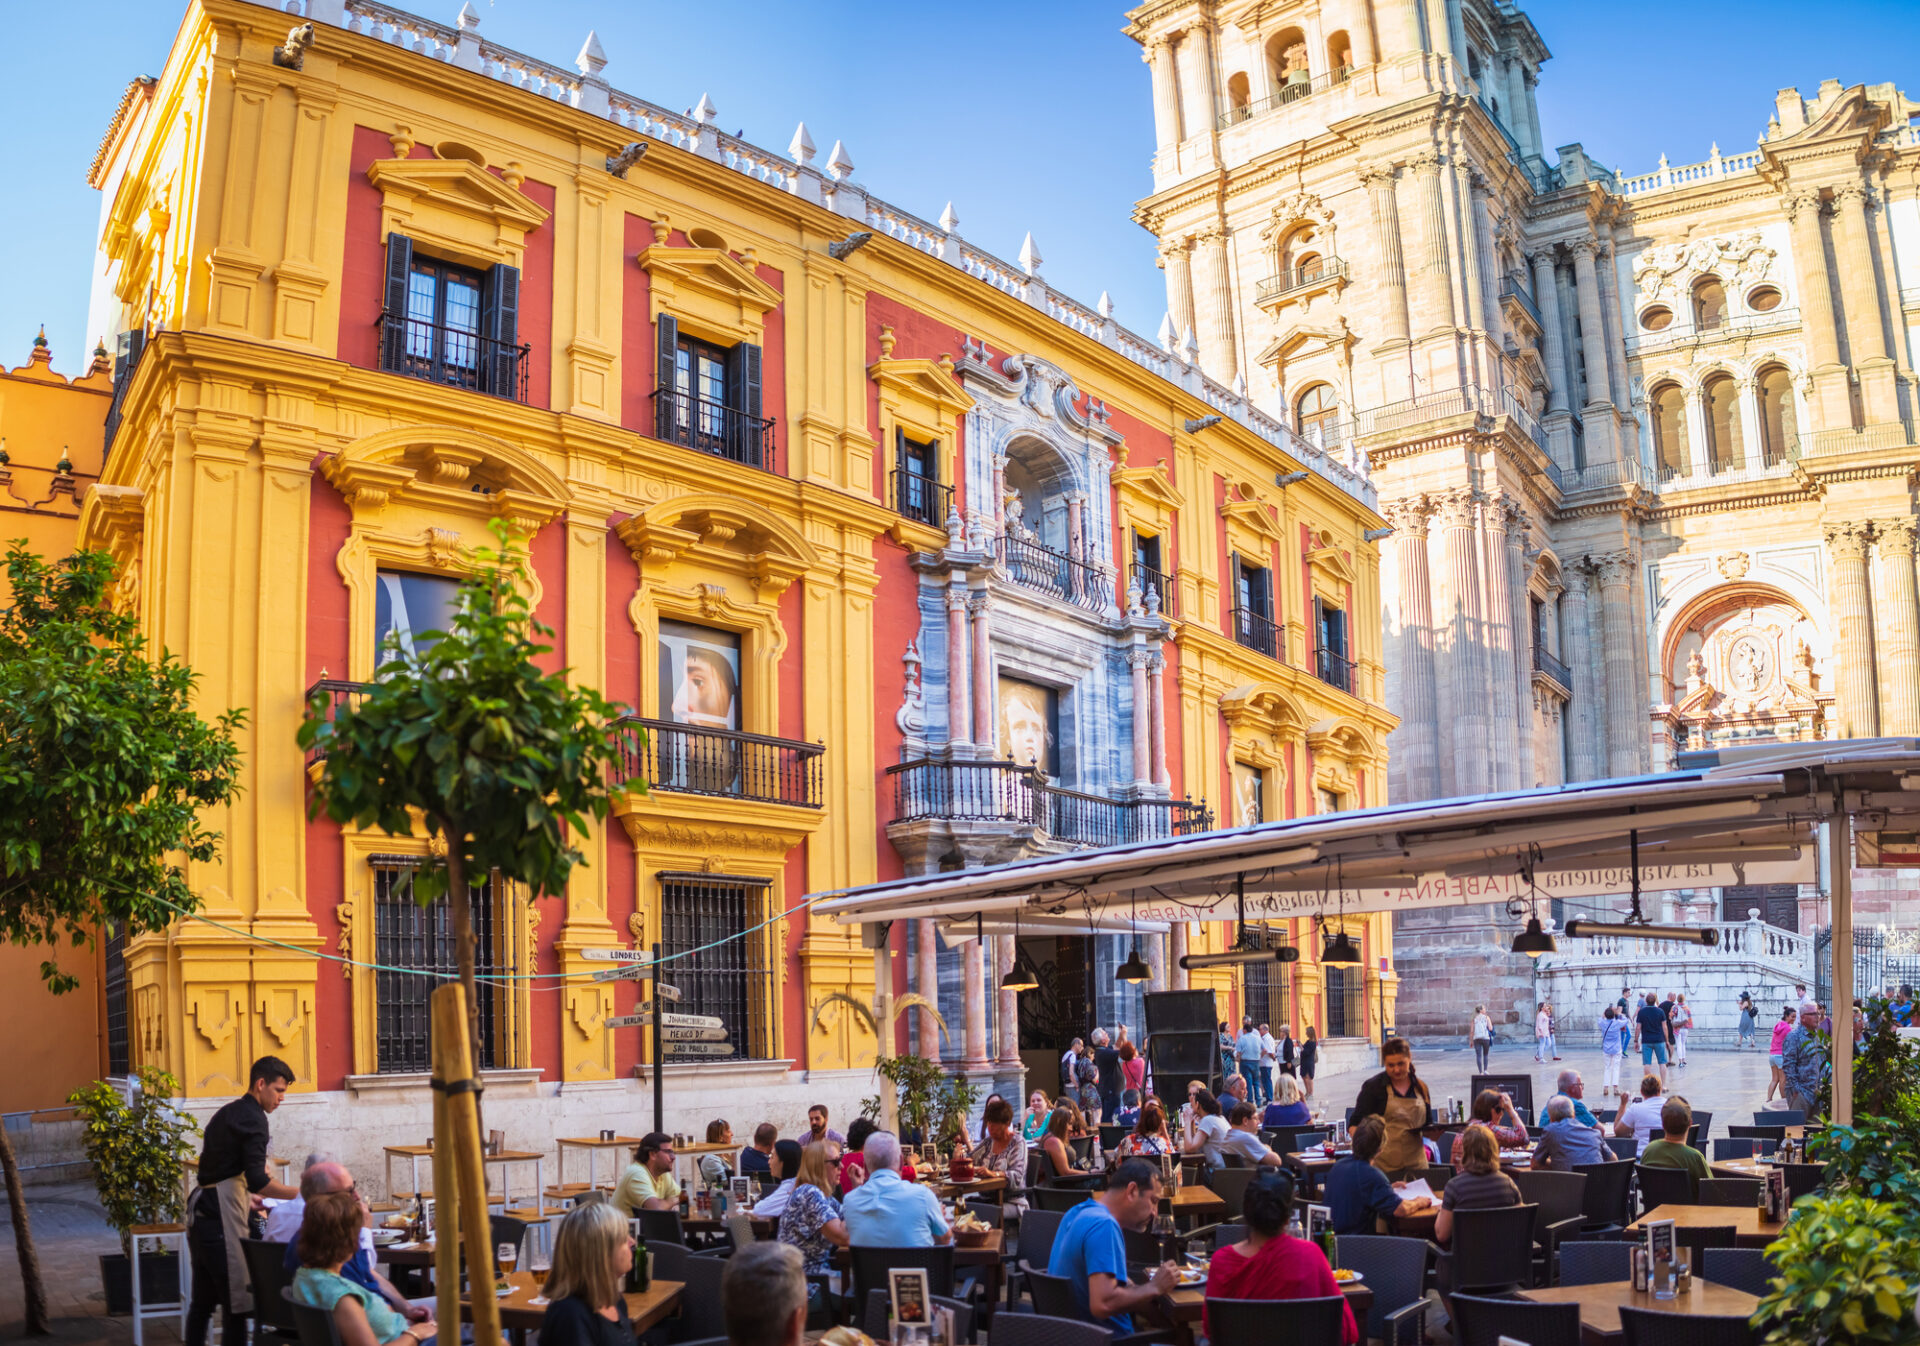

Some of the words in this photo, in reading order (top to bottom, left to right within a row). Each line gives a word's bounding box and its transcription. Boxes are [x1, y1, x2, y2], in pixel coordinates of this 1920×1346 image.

[610, 951, 642, 960] LONDRES
[623, 1016, 644, 1025] BERLIN
[688, 1045, 709, 1053] PAULO
